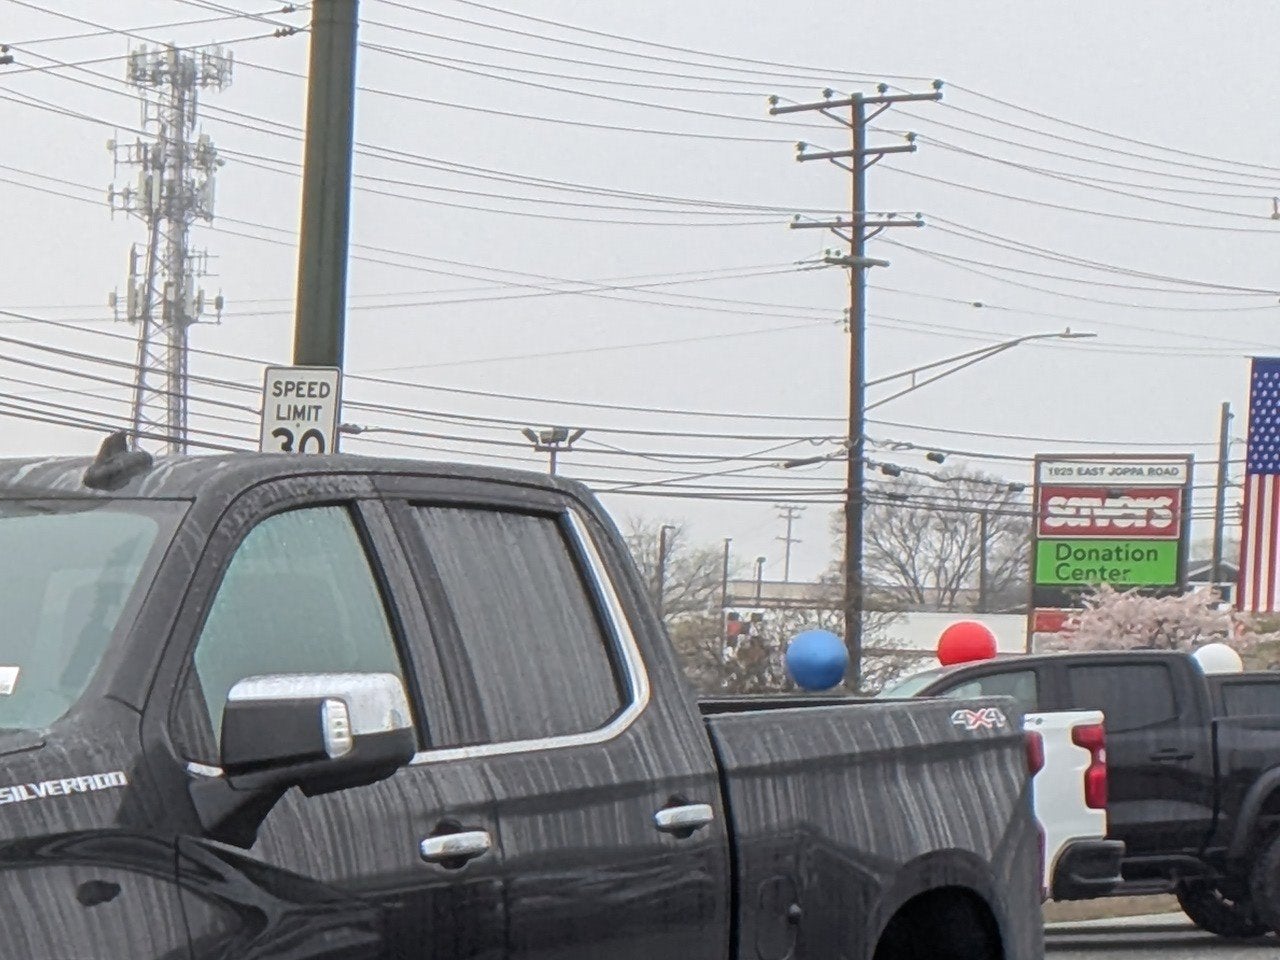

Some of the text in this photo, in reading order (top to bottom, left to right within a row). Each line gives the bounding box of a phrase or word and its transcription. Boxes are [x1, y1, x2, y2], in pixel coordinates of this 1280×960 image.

[272, 380, 331, 399] SPEED
[276, 404, 323, 422] LIMIT
[271, 427, 325, 454] 30
[1077, 467, 1106, 477] EAST
[1108, 467, 1144, 477] JOPPA
[1148, 467, 1180, 477] ROAD
[1056, 543, 1158, 562] Donation
[1055, 563, 1131, 581] Center
